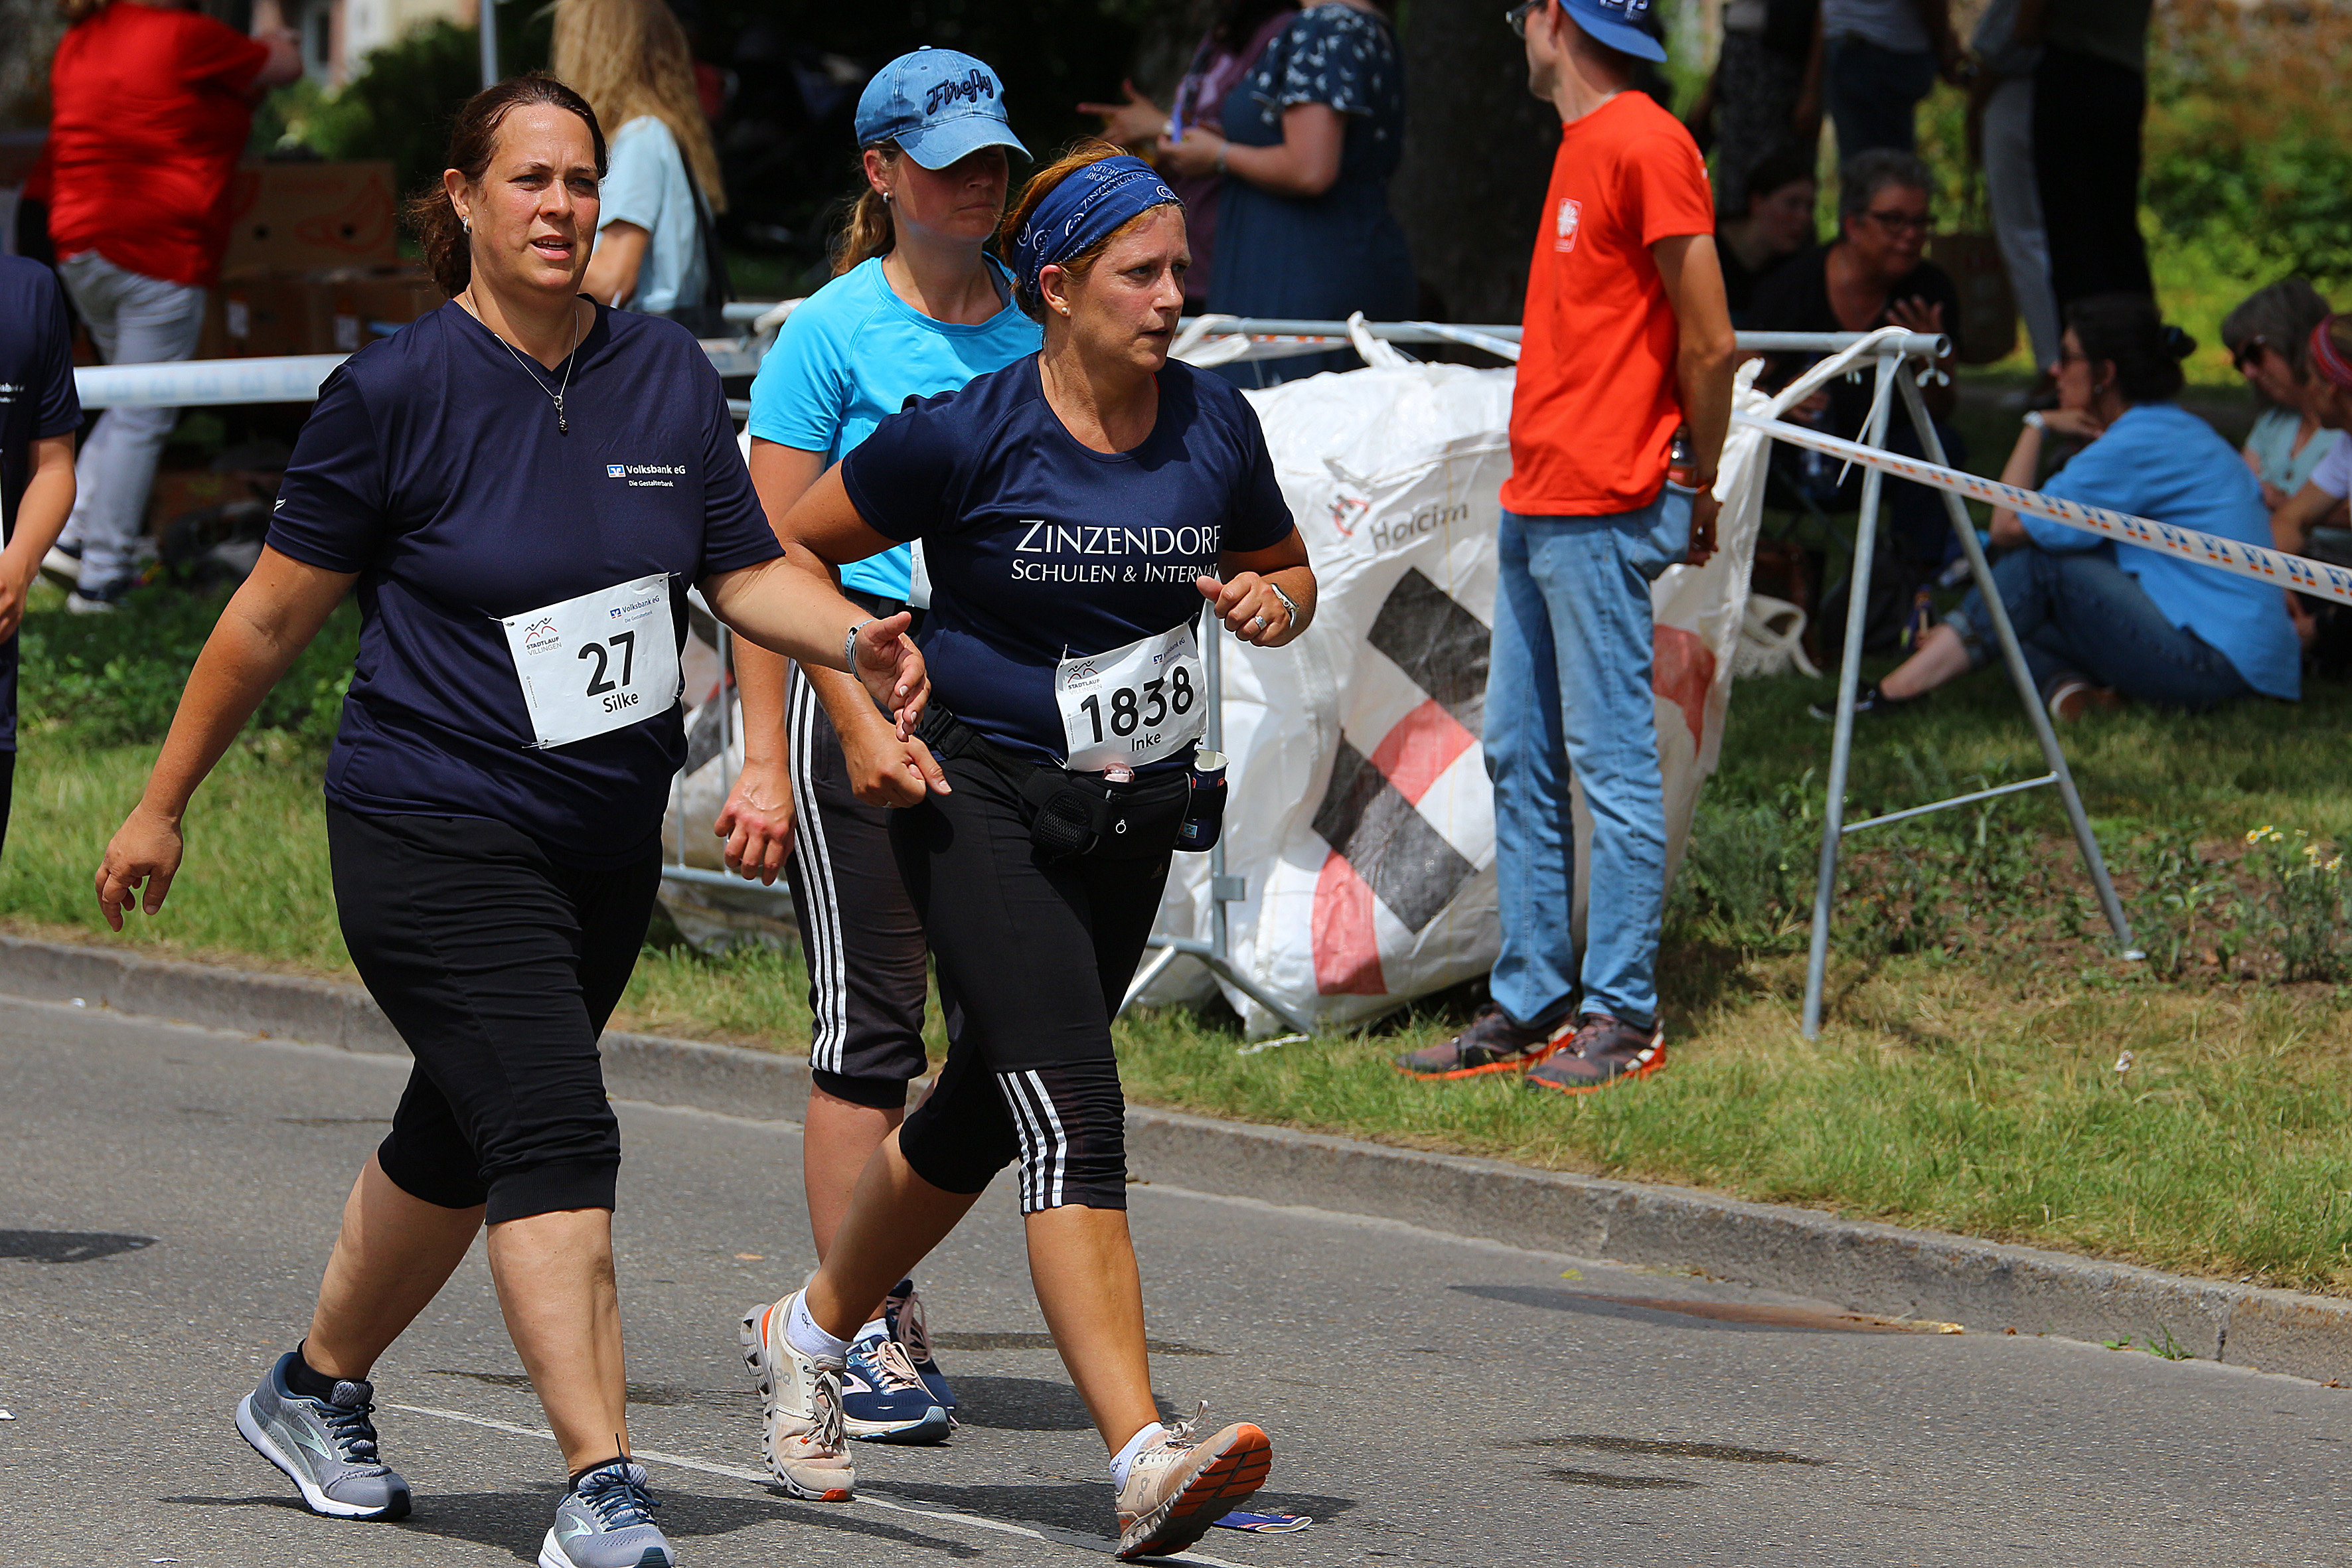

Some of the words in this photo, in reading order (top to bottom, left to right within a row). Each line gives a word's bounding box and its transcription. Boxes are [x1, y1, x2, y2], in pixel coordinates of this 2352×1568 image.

[926, 68, 994, 116] Firefly
[625, 464, 672, 475] Volksbank
[674, 465, 686, 475] eG
[1015, 519, 1221, 555] ZINZENDORF
[1011, 559, 1116, 583] SCHULEN
[1123, 565, 1137, 583] &
[622, 598, 651, 613] Volksbank
[652, 595, 660, 603] eG
[526, 636, 560, 650] STADTLAUF
[528, 642, 562, 656] VILLINGEN
[578, 629, 635, 698] 27
[1068, 678, 1100, 690] STADTLAUF
[1069, 684, 1103, 695] VILLINGEN
[602, 692, 639, 713] Silke
[1080, 665, 1194, 744] 1838
[1131, 733, 1162, 752] Inke
